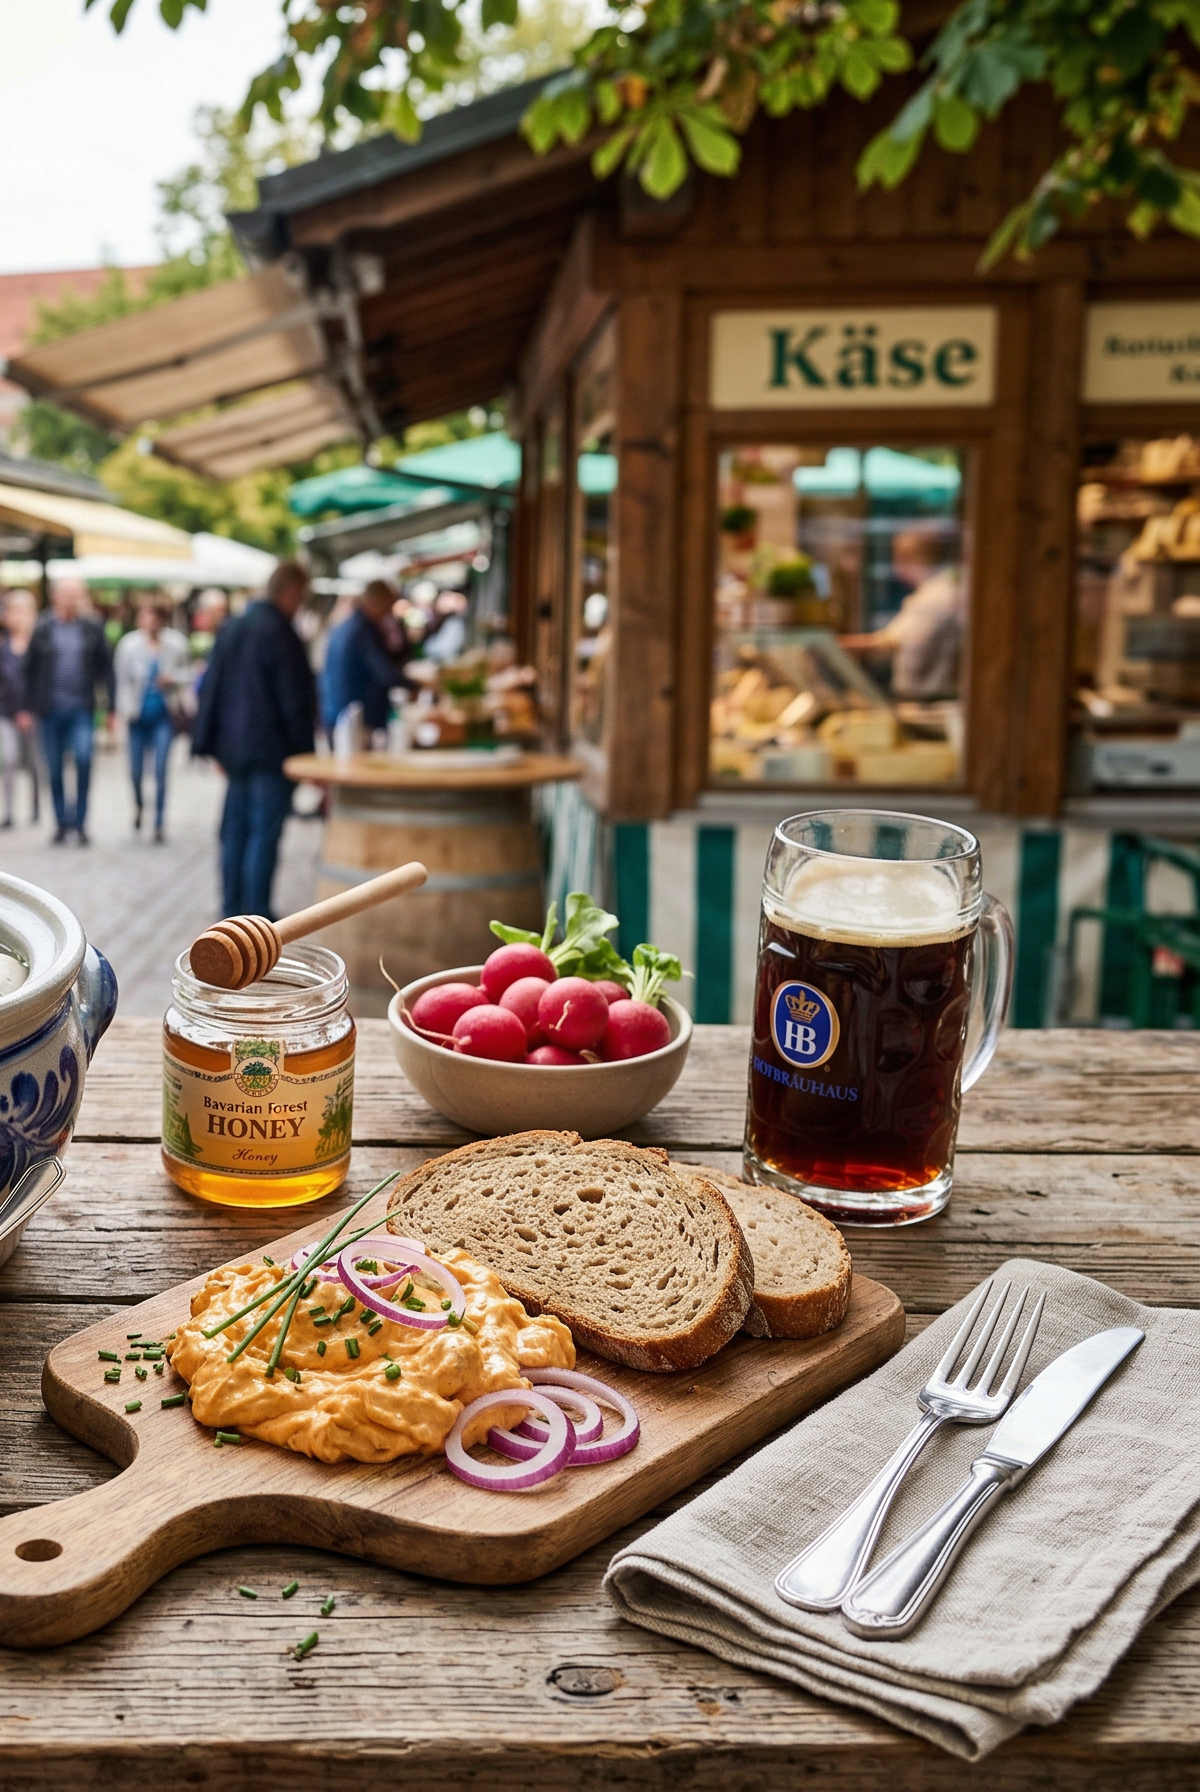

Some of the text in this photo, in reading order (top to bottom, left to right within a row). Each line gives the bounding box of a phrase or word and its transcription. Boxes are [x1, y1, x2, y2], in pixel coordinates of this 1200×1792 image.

[767, 322, 979, 391] Käse
[783, 1019, 816, 1055] HB
[203, 1095, 308, 1114] Bavarian Forest
[206, 1113, 306, 1139] HONEY
[232, 1149, 278, 1166] Honey
